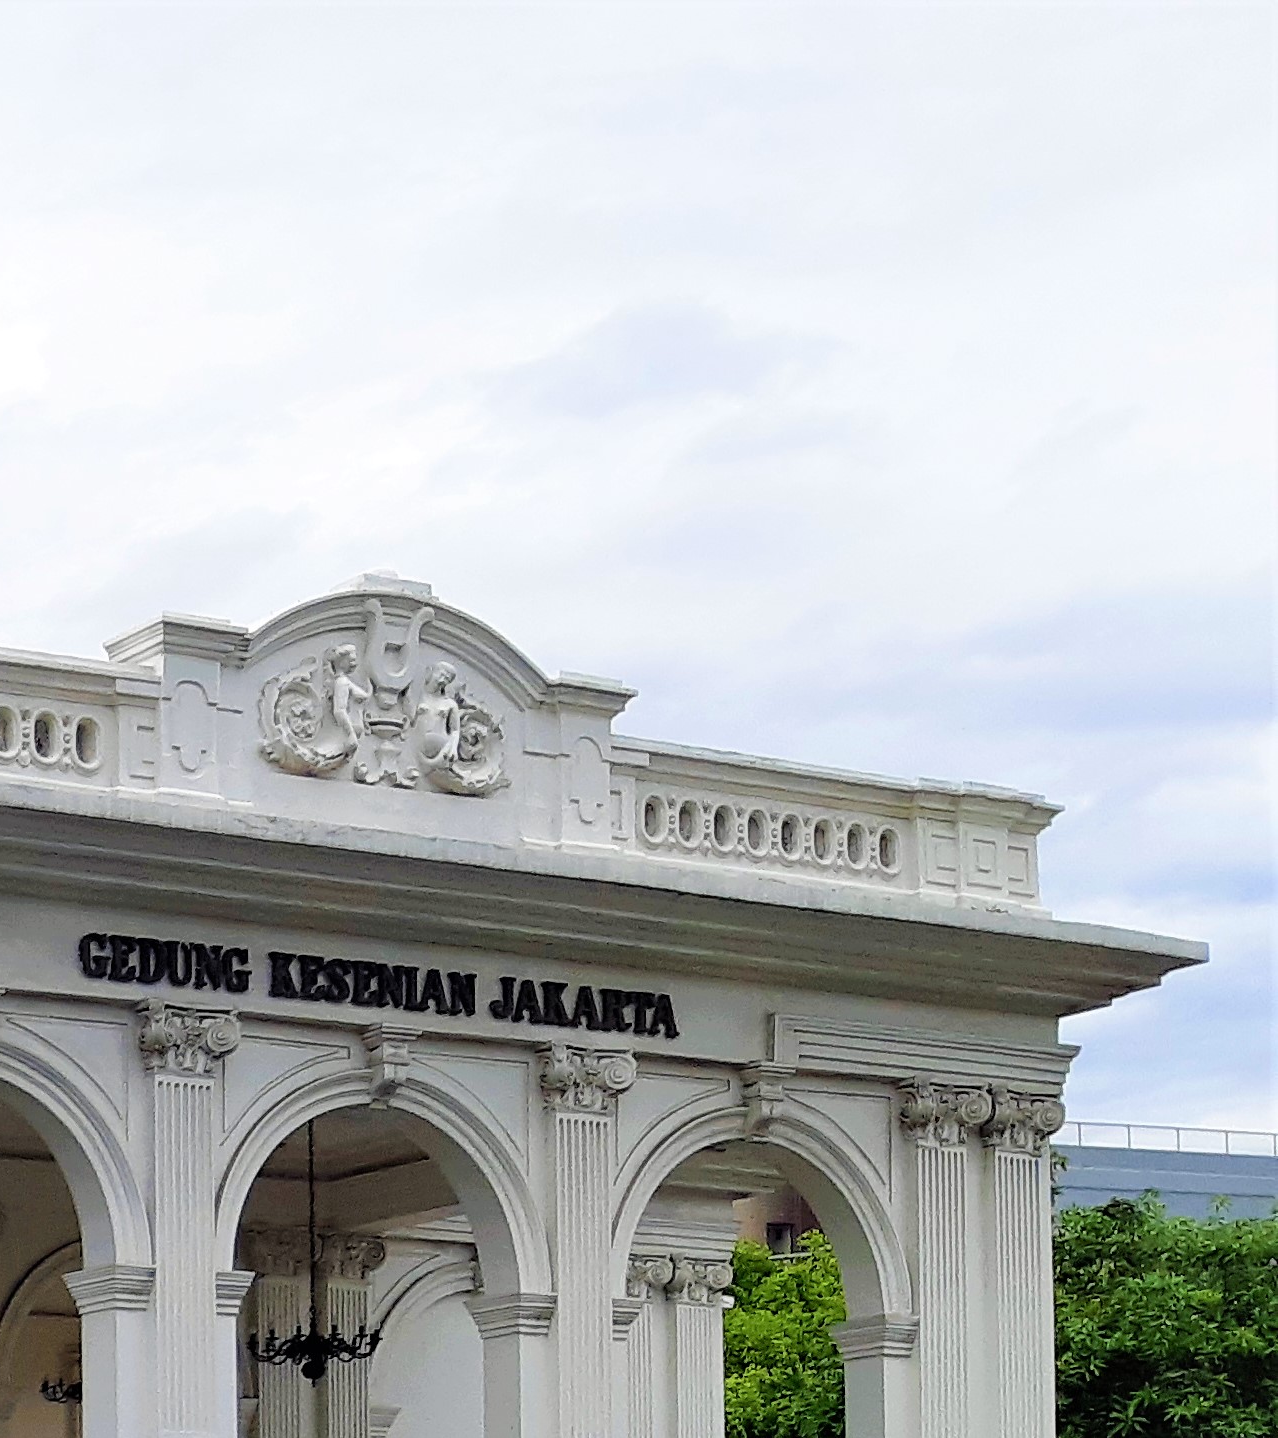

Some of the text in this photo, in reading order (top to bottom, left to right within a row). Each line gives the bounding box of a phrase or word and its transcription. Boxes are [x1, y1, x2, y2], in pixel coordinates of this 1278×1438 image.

[77, 932, 681, 1039] GEDUNG KESENIAN JAKARTA
